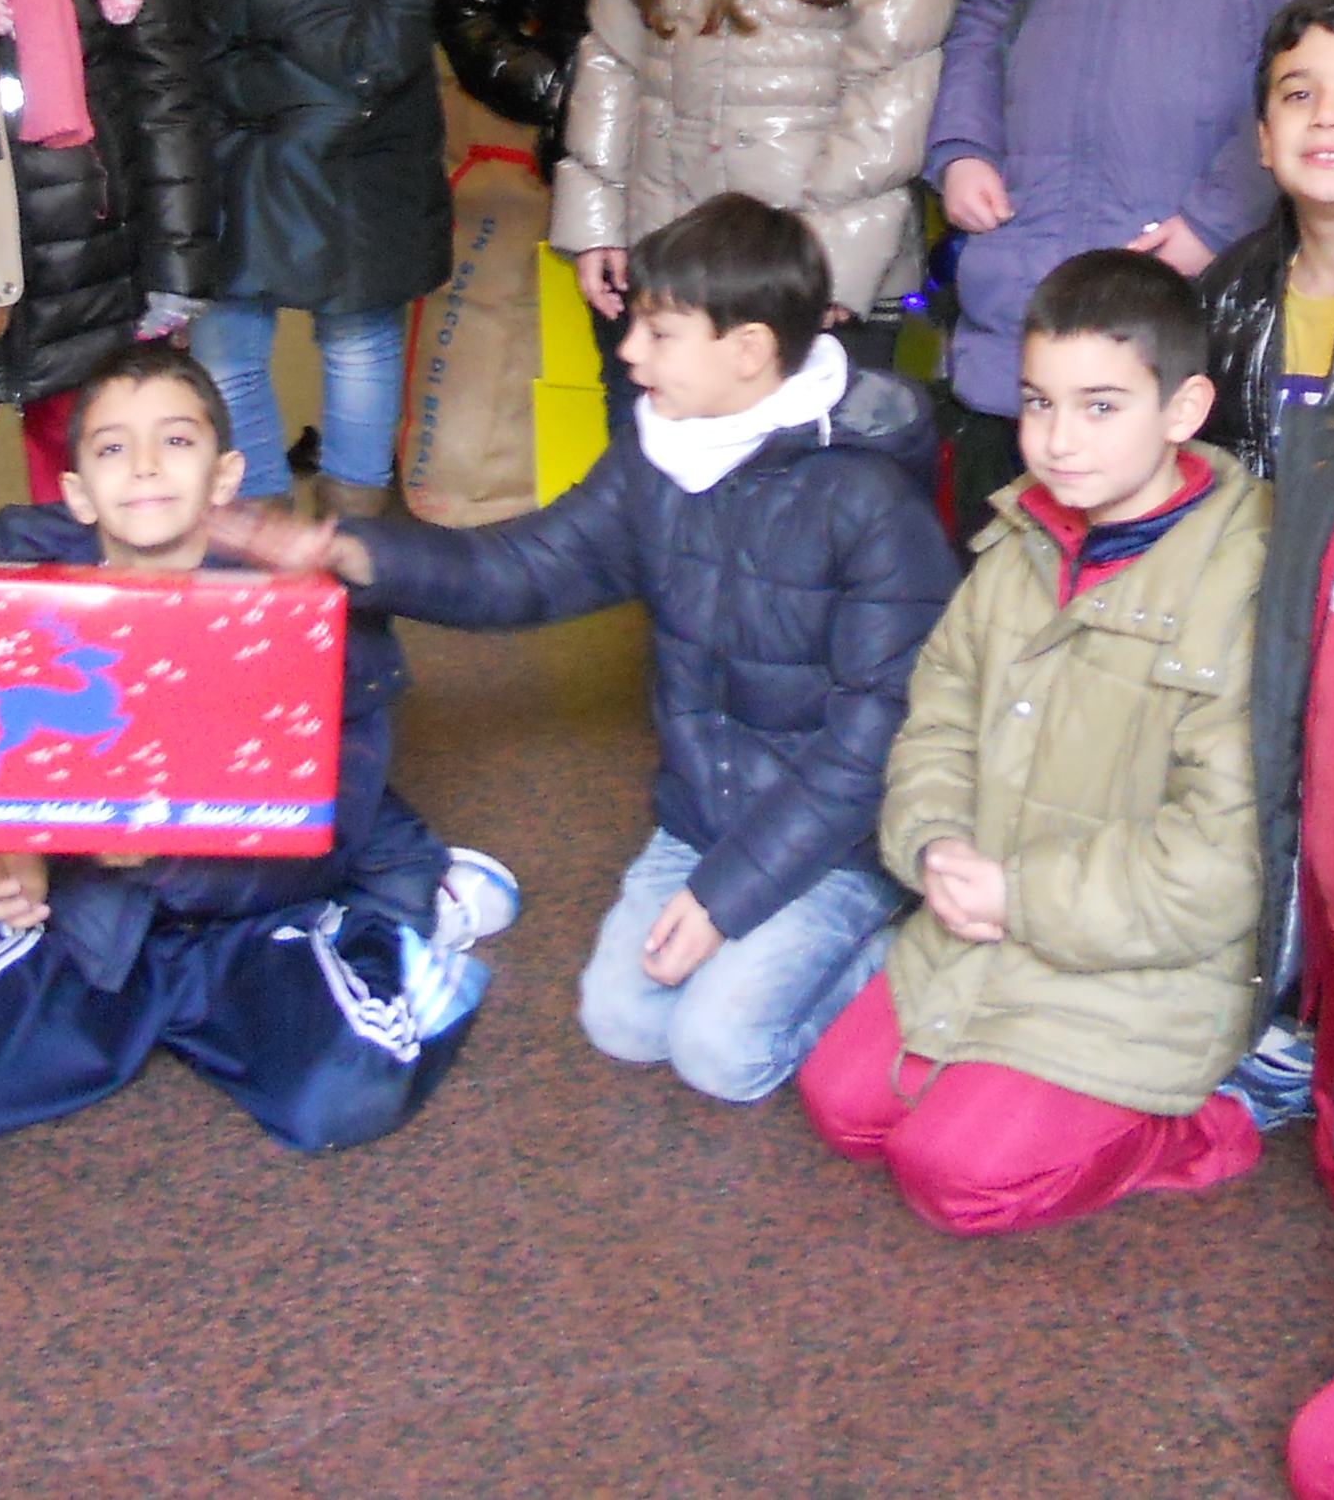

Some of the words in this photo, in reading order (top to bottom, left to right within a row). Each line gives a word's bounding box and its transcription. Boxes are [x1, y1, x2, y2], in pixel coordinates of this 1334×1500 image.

[471, 216, 497, 252] UN
[436, 261, 475, 348] SACCO
[427, 355, 448, 385] DI
